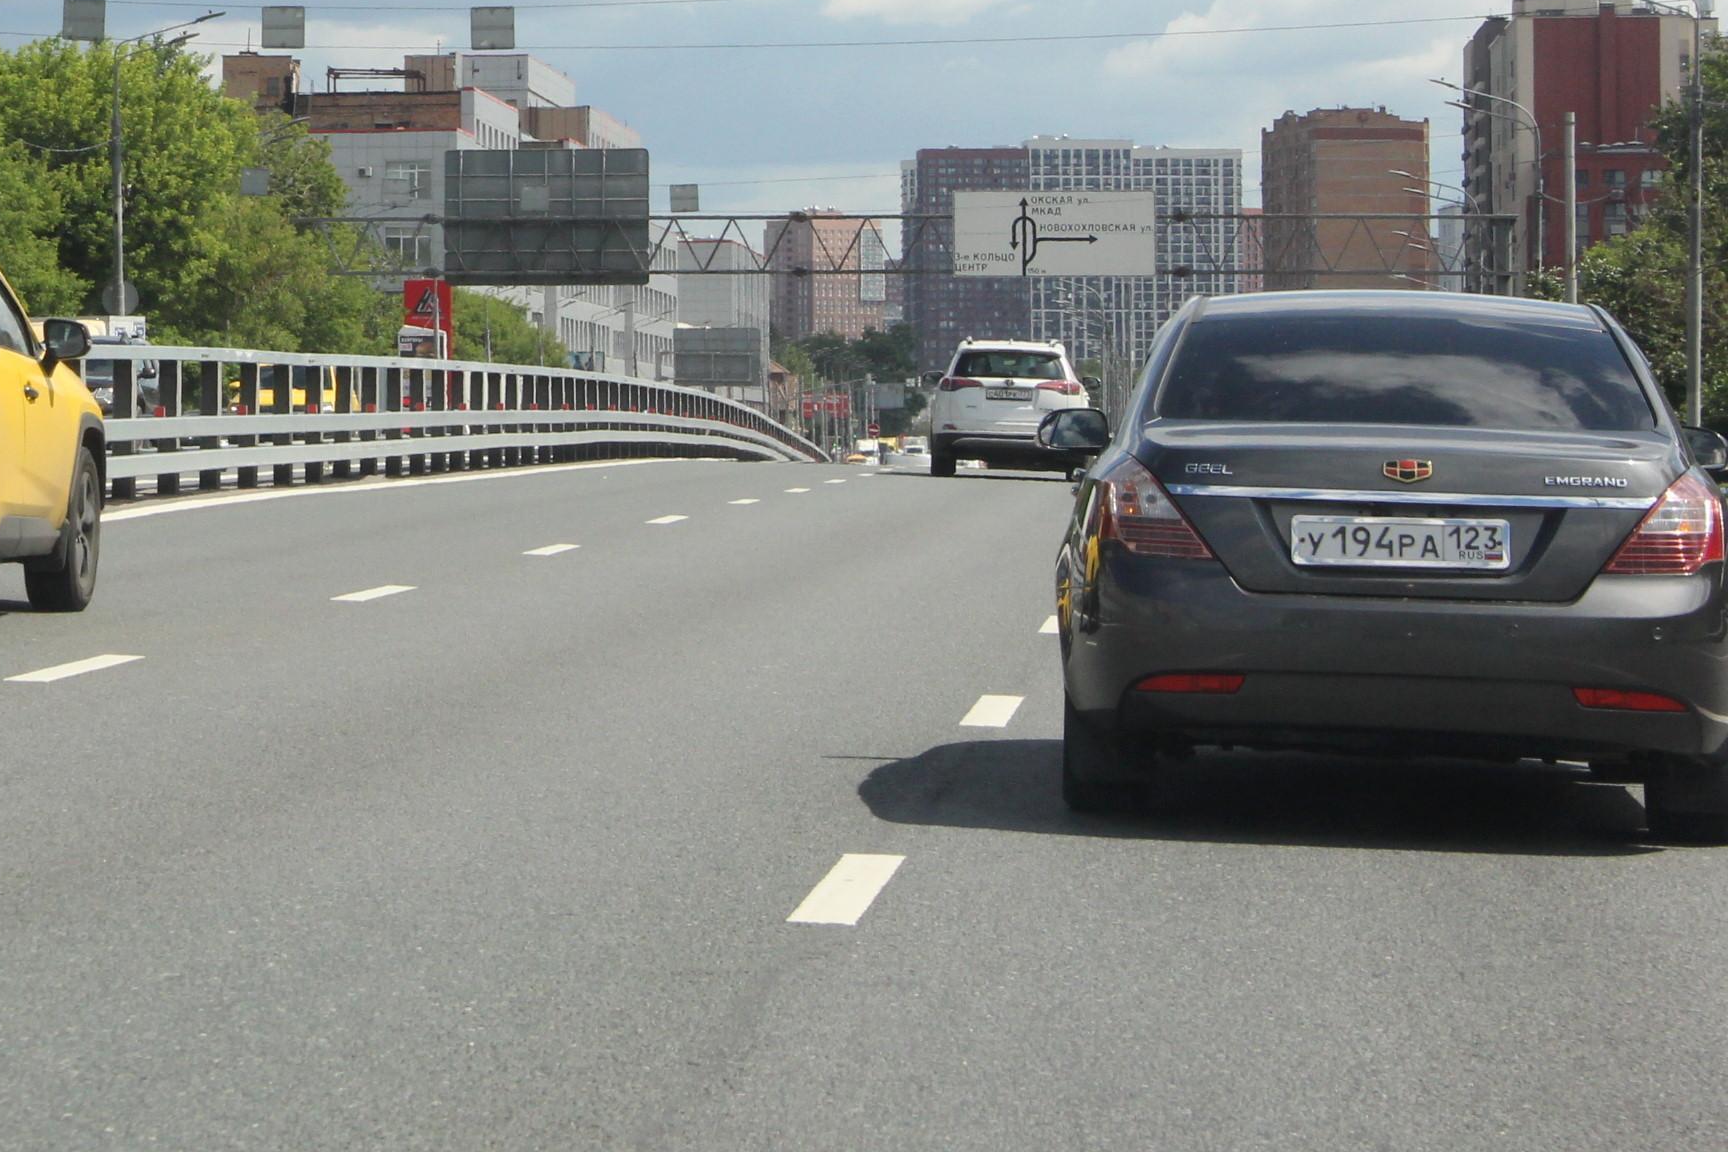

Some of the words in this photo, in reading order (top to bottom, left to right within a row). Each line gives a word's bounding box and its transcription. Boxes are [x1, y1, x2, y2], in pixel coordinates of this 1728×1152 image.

[1030, 196, 1072, 205] ОКСКАЯ
[1031, 207, 1062, 216] МКАД
[1039, 223, 1136, 232] НОВОХОХЛОВСКАЯ
[972, 253, 1015, 262] КОЛЬЦО
[955, 263, 988, 272] ЦЕНТР
[1544, 475, 1628, 488] EMGRAND
[1448, 524, 1498, 550] 123
[1458, 550, 1484, 560] RUS
